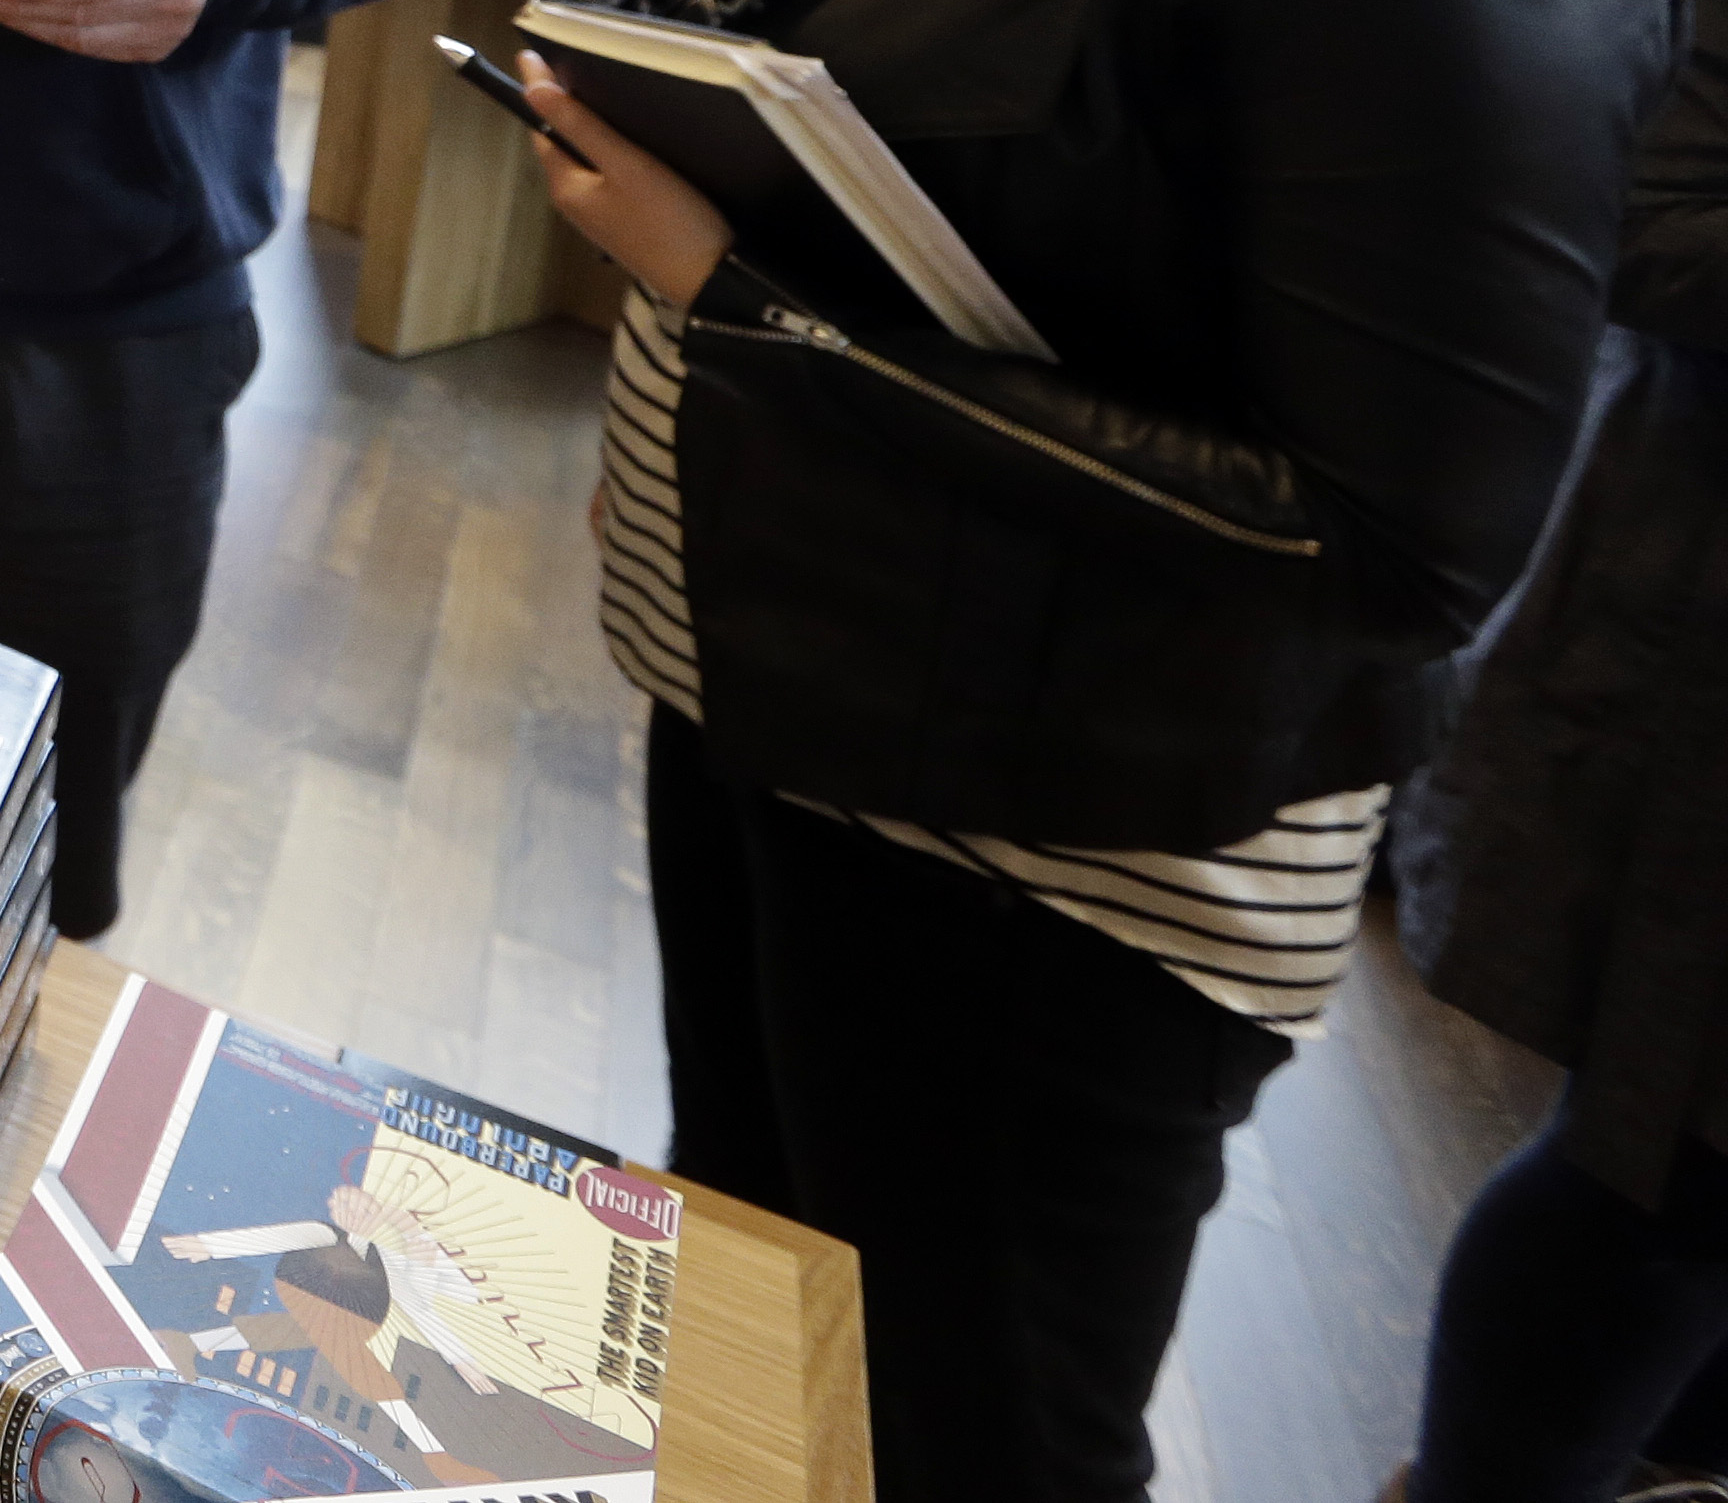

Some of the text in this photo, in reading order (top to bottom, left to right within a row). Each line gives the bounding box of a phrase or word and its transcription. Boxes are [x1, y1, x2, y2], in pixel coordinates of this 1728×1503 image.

[383, 1104, 568, 1197] PAPERBOUND
[585, 1169, 681, 1240] OFFICIAL
[597, 1236, 642, 1390] THE SMARTEST
[633, 1246, 676, 1402] KID ON EARTH
